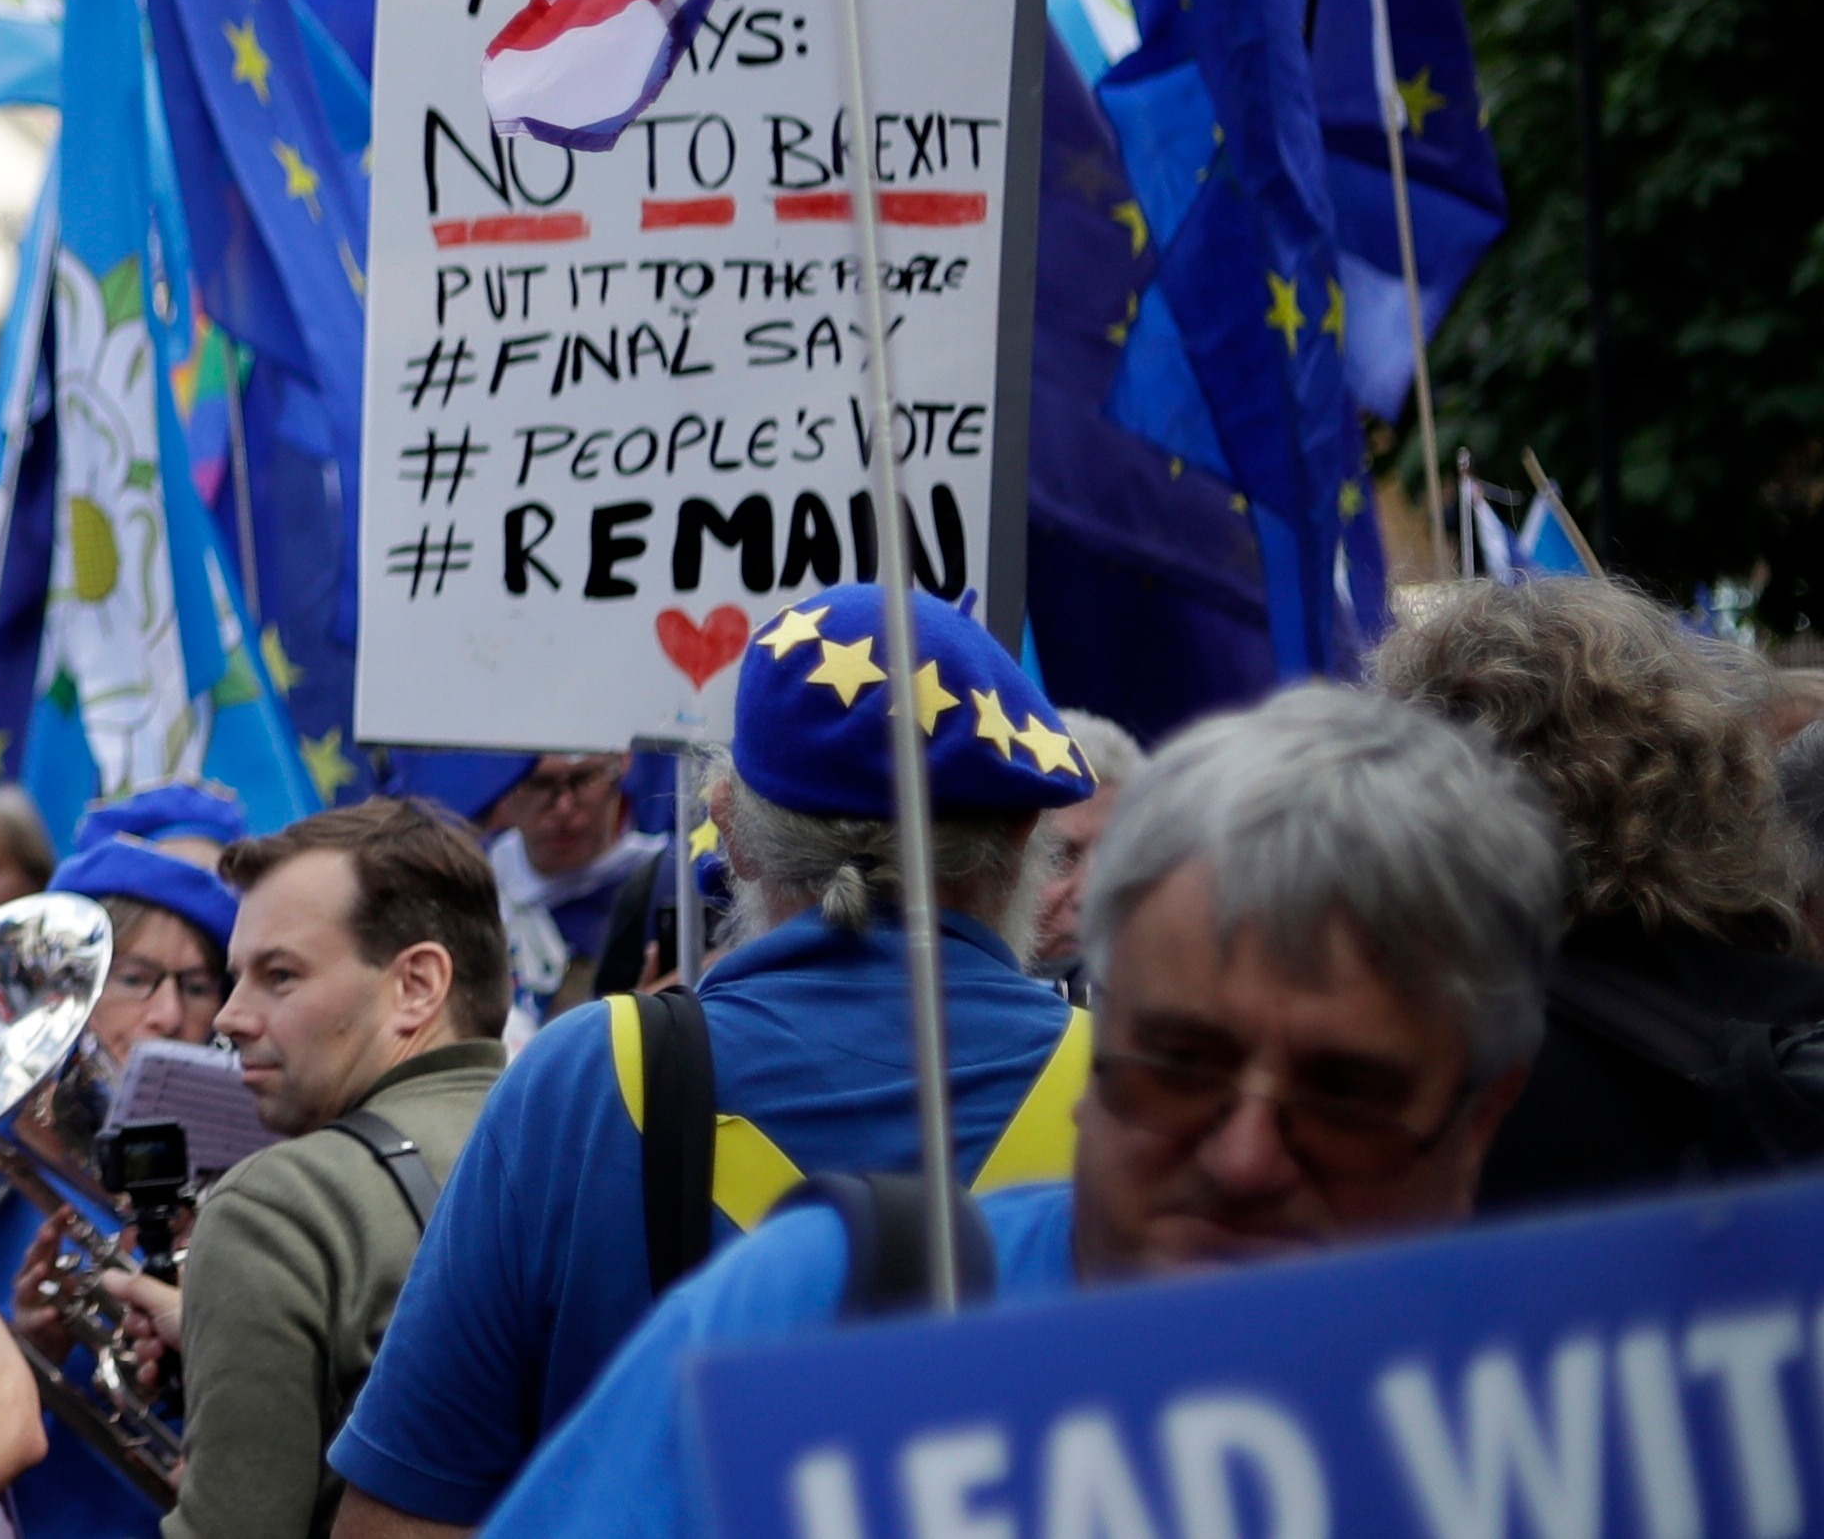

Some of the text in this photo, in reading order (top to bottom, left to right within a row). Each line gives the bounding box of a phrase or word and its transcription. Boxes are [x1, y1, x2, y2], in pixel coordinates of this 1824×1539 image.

[688, 3, 809, 74] YS:
[424, 108, 576, 214] NO
[630, 114, 736, 190] TO
[436, 253, 969, 325] PUT IT TO THE POPLE
[1374, 1303, 1824, 1539] WIT
